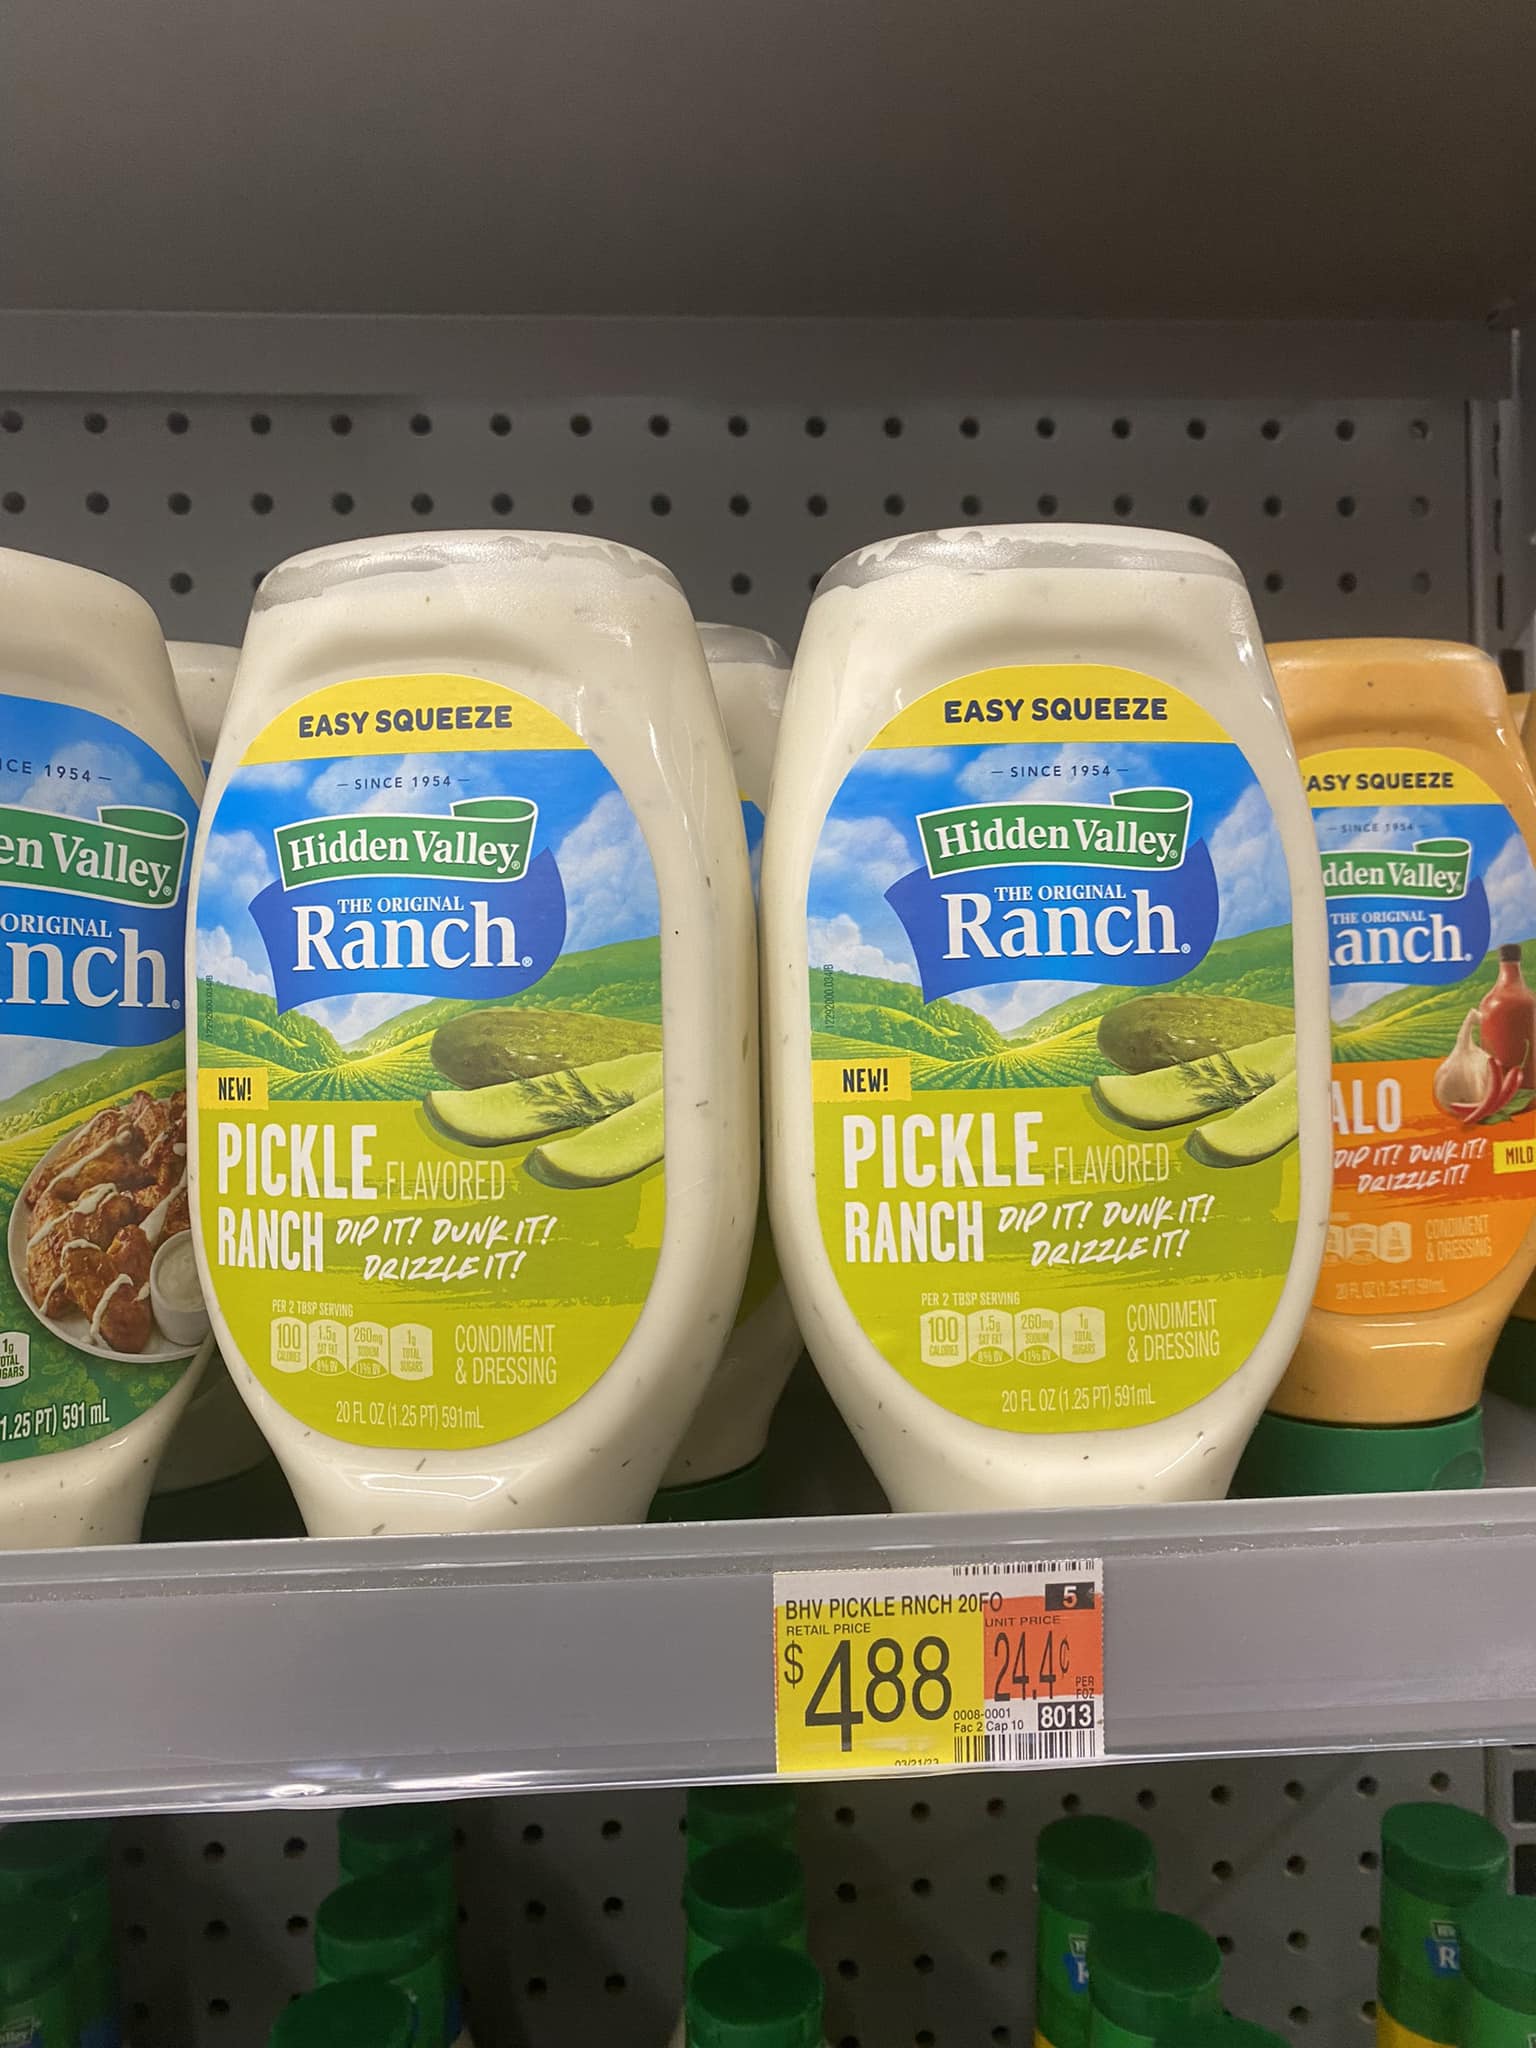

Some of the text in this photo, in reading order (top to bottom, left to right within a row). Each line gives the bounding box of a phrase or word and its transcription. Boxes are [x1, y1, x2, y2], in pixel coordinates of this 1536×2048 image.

[299, 704, 513, 739] EASY SQUEEZE
[944, 696, 1168, 724] EASY SQUEEZE
[0, 757, 91, 783] CE 1954
[354, 775, 451, 791] SINCE 1954
[1010, 764, 1111, 779] SINCE 1954
[1303, 772, 1454, 792] ASY SQUEEZE
[934, 816, 1176, 863] Hidden Valley
[1340, 823, 1414, 834] SINCE 1954
[49, 831, 172, 899] Valley
[287, 828, 519, 874] Hidden Valley
[1386, 861, 1462, 893] Valley
[337, 895, 464, 914] THE ORIGINAL
[994, 884, 1127, 903] THE ORIGINAL
[0, 911, 112, 939] ORIGINAL
[940, 889, 1181, 960] Ranch
[1330, 910, 1426, 925] THE ORIGINAL
[292, 901, 521, 973] Ranch
[1328, 914, 1464, 967] anch
[0, 927, 171, 1009] nch
[218, 1077, 252, 1102] NEW!
[842, 1068, 889, 1093] NEW!
[218, 1121, 506, 1201] PICKLE FLAVORED
[842, 1111, 1170, 1189] PICKLE FLAVORED
[1333, 1138, 1487, 1169] DIP IT! DUNK IT!
[1506, 1146, 1534, 1165] MILD
[1357, 1164, 1470, 1194] DRIZZLE IT!
[998, 1194, 1215, 1233] DIP IT! DUNK IT!
[218, 1206, 324, 1273] RANCH
[335, 1215, 557, 1251] DIP IT! DUNK IT!
[845, 1200, 984, 1263] RANCH
[1030, 1230, 1190, 1267] DRIZZLE IT!
[363, 1250, 527, 1282] DRIZZLE IT!
[272, 1299, 353, 1318] PER 2 TBSP SERVING
[921, 1291, 1020, 1307] PER 2 TBSP SERVING
[928, 1316, 959, 1343] 100
[979, 1315, 1000, 1332] 1.5g
[1021, 1313, 1054, 1331] 260mg
[1079, 1312, 1089, 1329] 1g
[1127, 1299, 1217, 1332] CONDIMENT
[277, 1322, 301, 1350] 100
[318, 1326, 337, 1342] 1.5g
[354, 1327, 383, 1345] 260mg
[407, 1329, 416, 1346] 1g
[455, 1323, 556, 1354] CONDIMENT
[1127, 1328, 1220, 1363] & DRESSING
[0, 1354, 20, 1368] OTAL
[455, 1356, 557, 1385] & DRESSING
[1001, 1384, 1155, 1413] 20 FL OZ (1.25 PT) 591mL
[35, 1403, 57, 1436] PT)
[62, 1401, 86, 1431] 591
[90, 1398, 110, 1426] mL
[336, 1400, 484, 1431] 20 FL OZ (1.25 PT) 591mL
[785, 1591, 1003, 1621] BHV PICKLE RNCH 20FO
[1062, 1585, 1078, 1608] 5
[786, 1622, 871, 1636] RETAIL PRICE
[985, 1615, 1062, 1628] UNIT PRICE
[1075, 1675, 1095, 1687] PER
[1076, 1688, 1095, 1700] FOZ
[953, 1708, 1011, 1721] 0008-0001
[954, 1719, 1024, 1734] Fac 2 Cap 10
[1040, 1703, 1092, 1729] 8013
